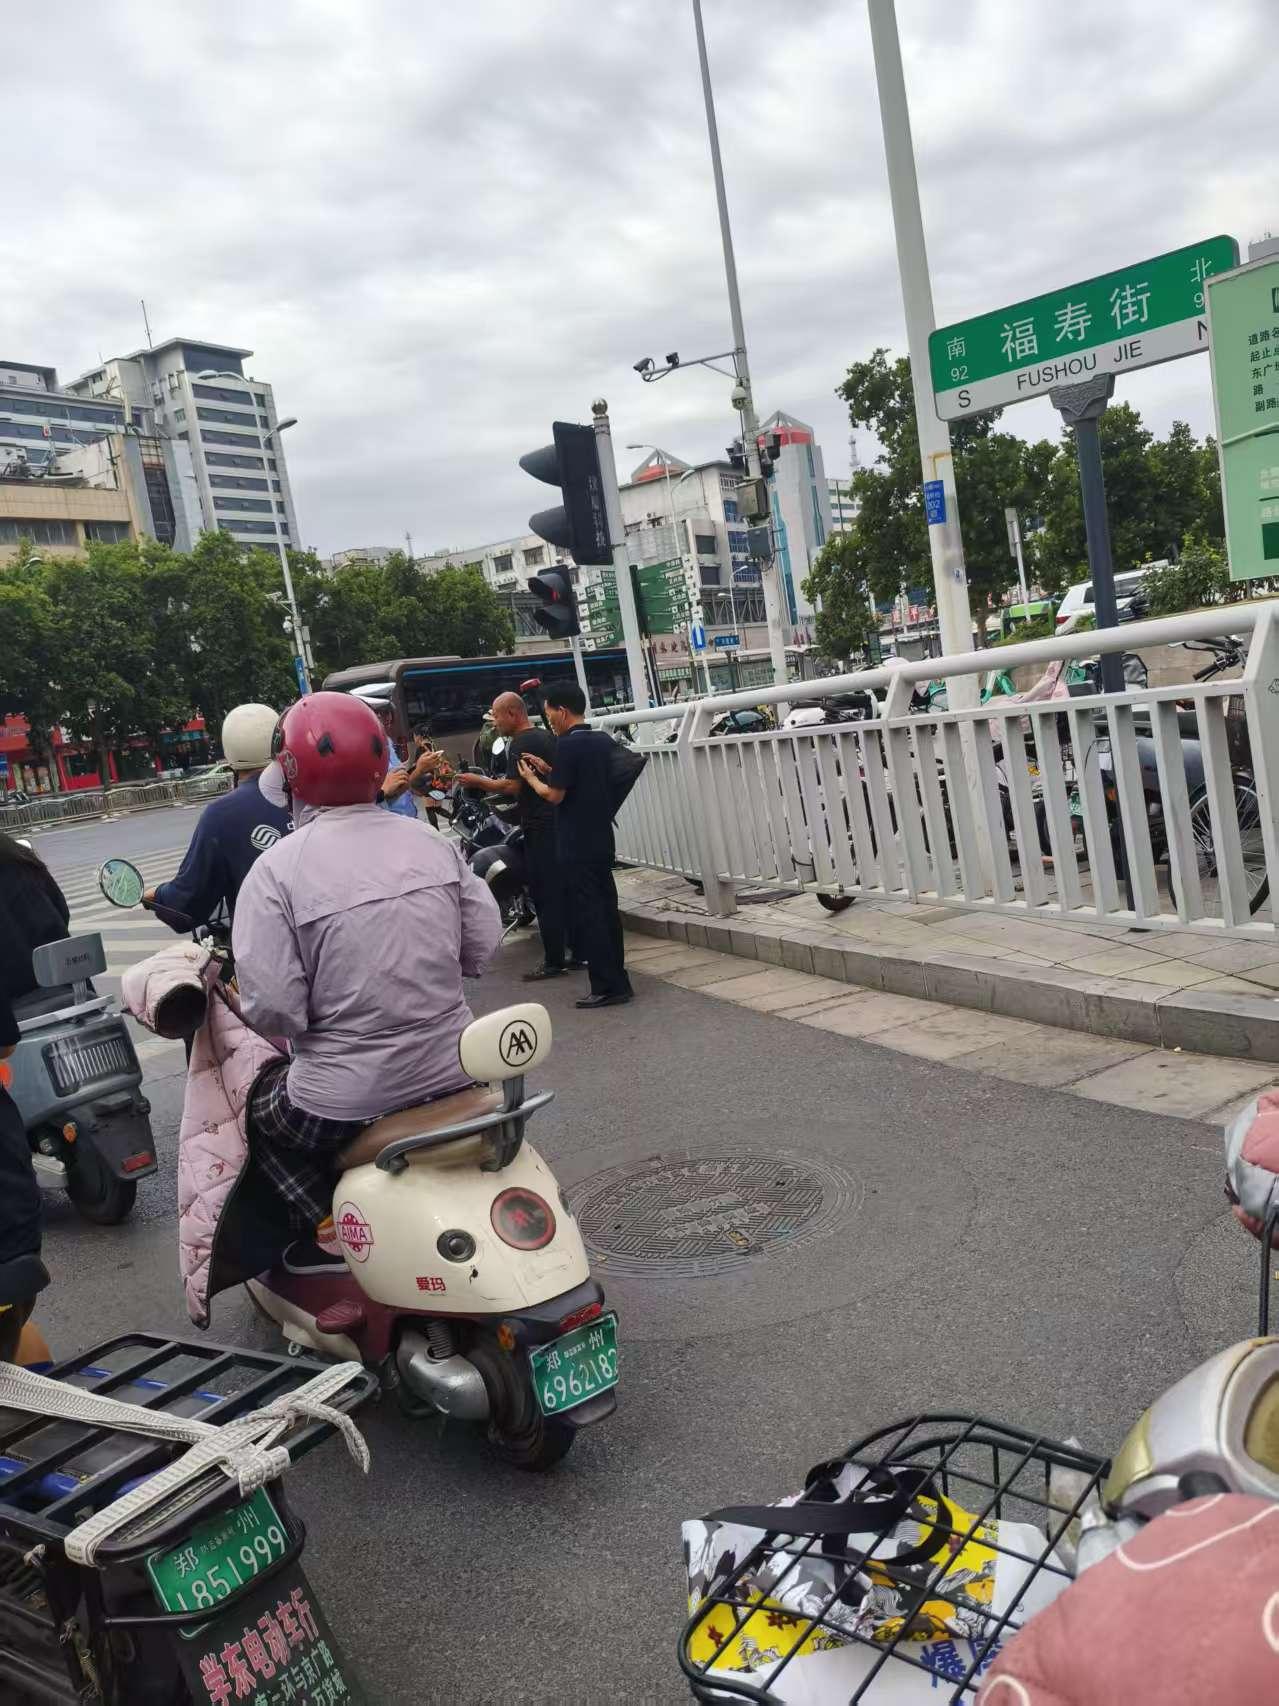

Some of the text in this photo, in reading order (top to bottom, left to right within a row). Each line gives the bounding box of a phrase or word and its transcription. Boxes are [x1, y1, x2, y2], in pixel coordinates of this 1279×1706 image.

[946, 257, 1212, 363] 南 福寿街 北
[951, 292, 1206, 381] 92 9
[958, 389, 972, 408] S
[1017, 353, 1098, 391] FUSHOU
[1113, 340, 1143, 363] JIE
[341, 1226, 368, 1241] AIMA
[415, 1276, 446, 1292] 爱玛
[546, 1350, 561, 1373] 郑
[588, 1328, 605, 1350] 州
[174, 1505, 260, 1578] 郑 州
[176, 1525, 286, 1611] 1851999
